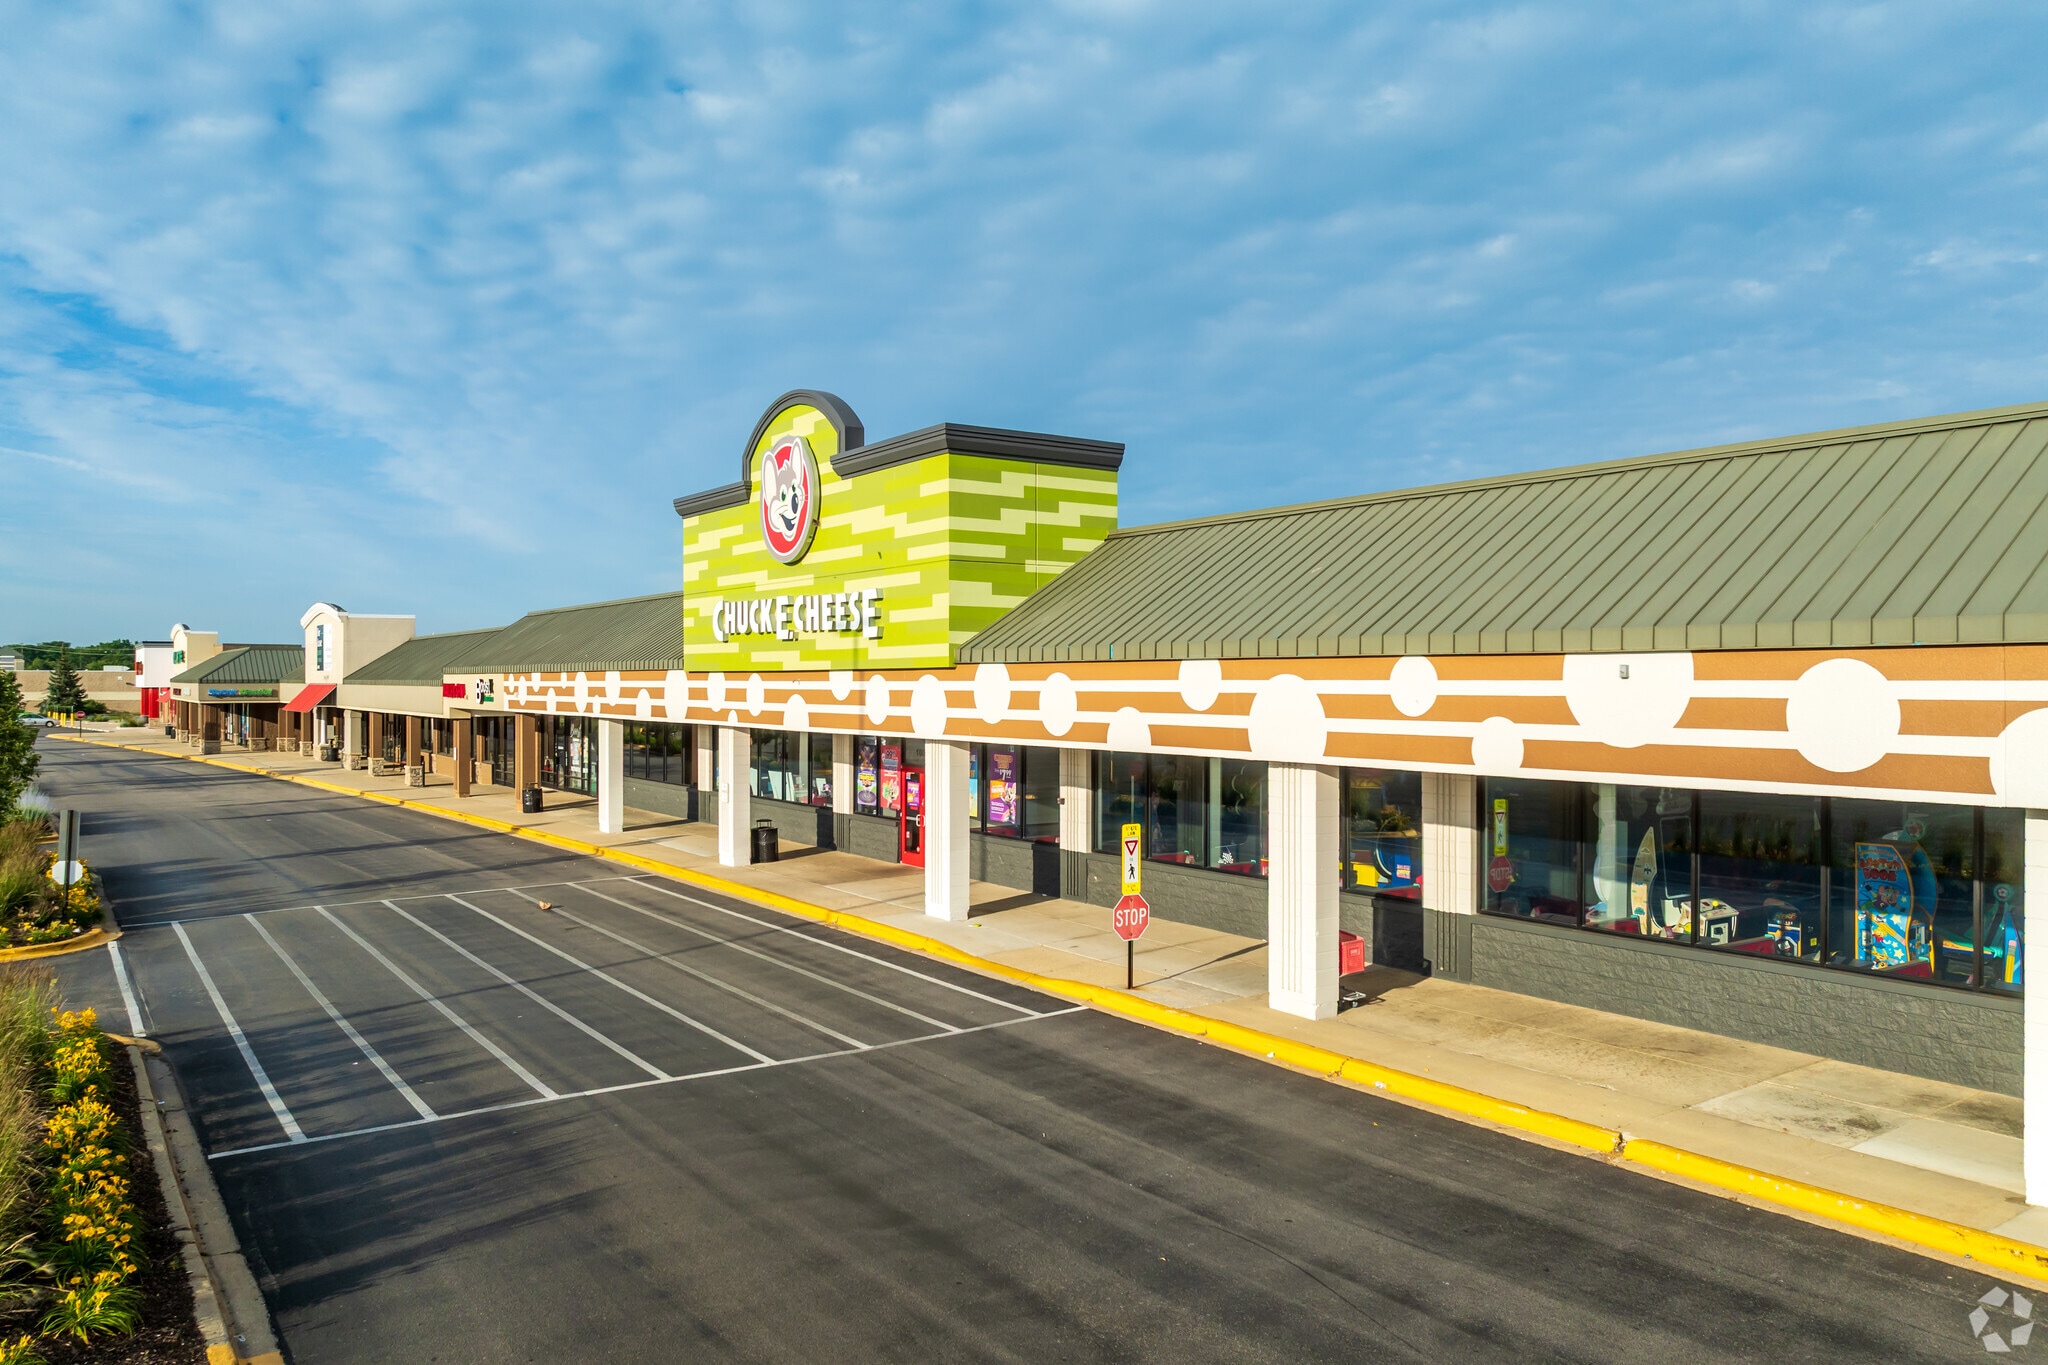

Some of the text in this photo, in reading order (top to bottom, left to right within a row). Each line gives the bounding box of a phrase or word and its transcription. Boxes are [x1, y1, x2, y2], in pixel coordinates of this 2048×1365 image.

[712, 598, 775, 642] CHUCK
[793, 588, 883, 640] CHEESE
[1115, 907, 1147, 928] STOP
